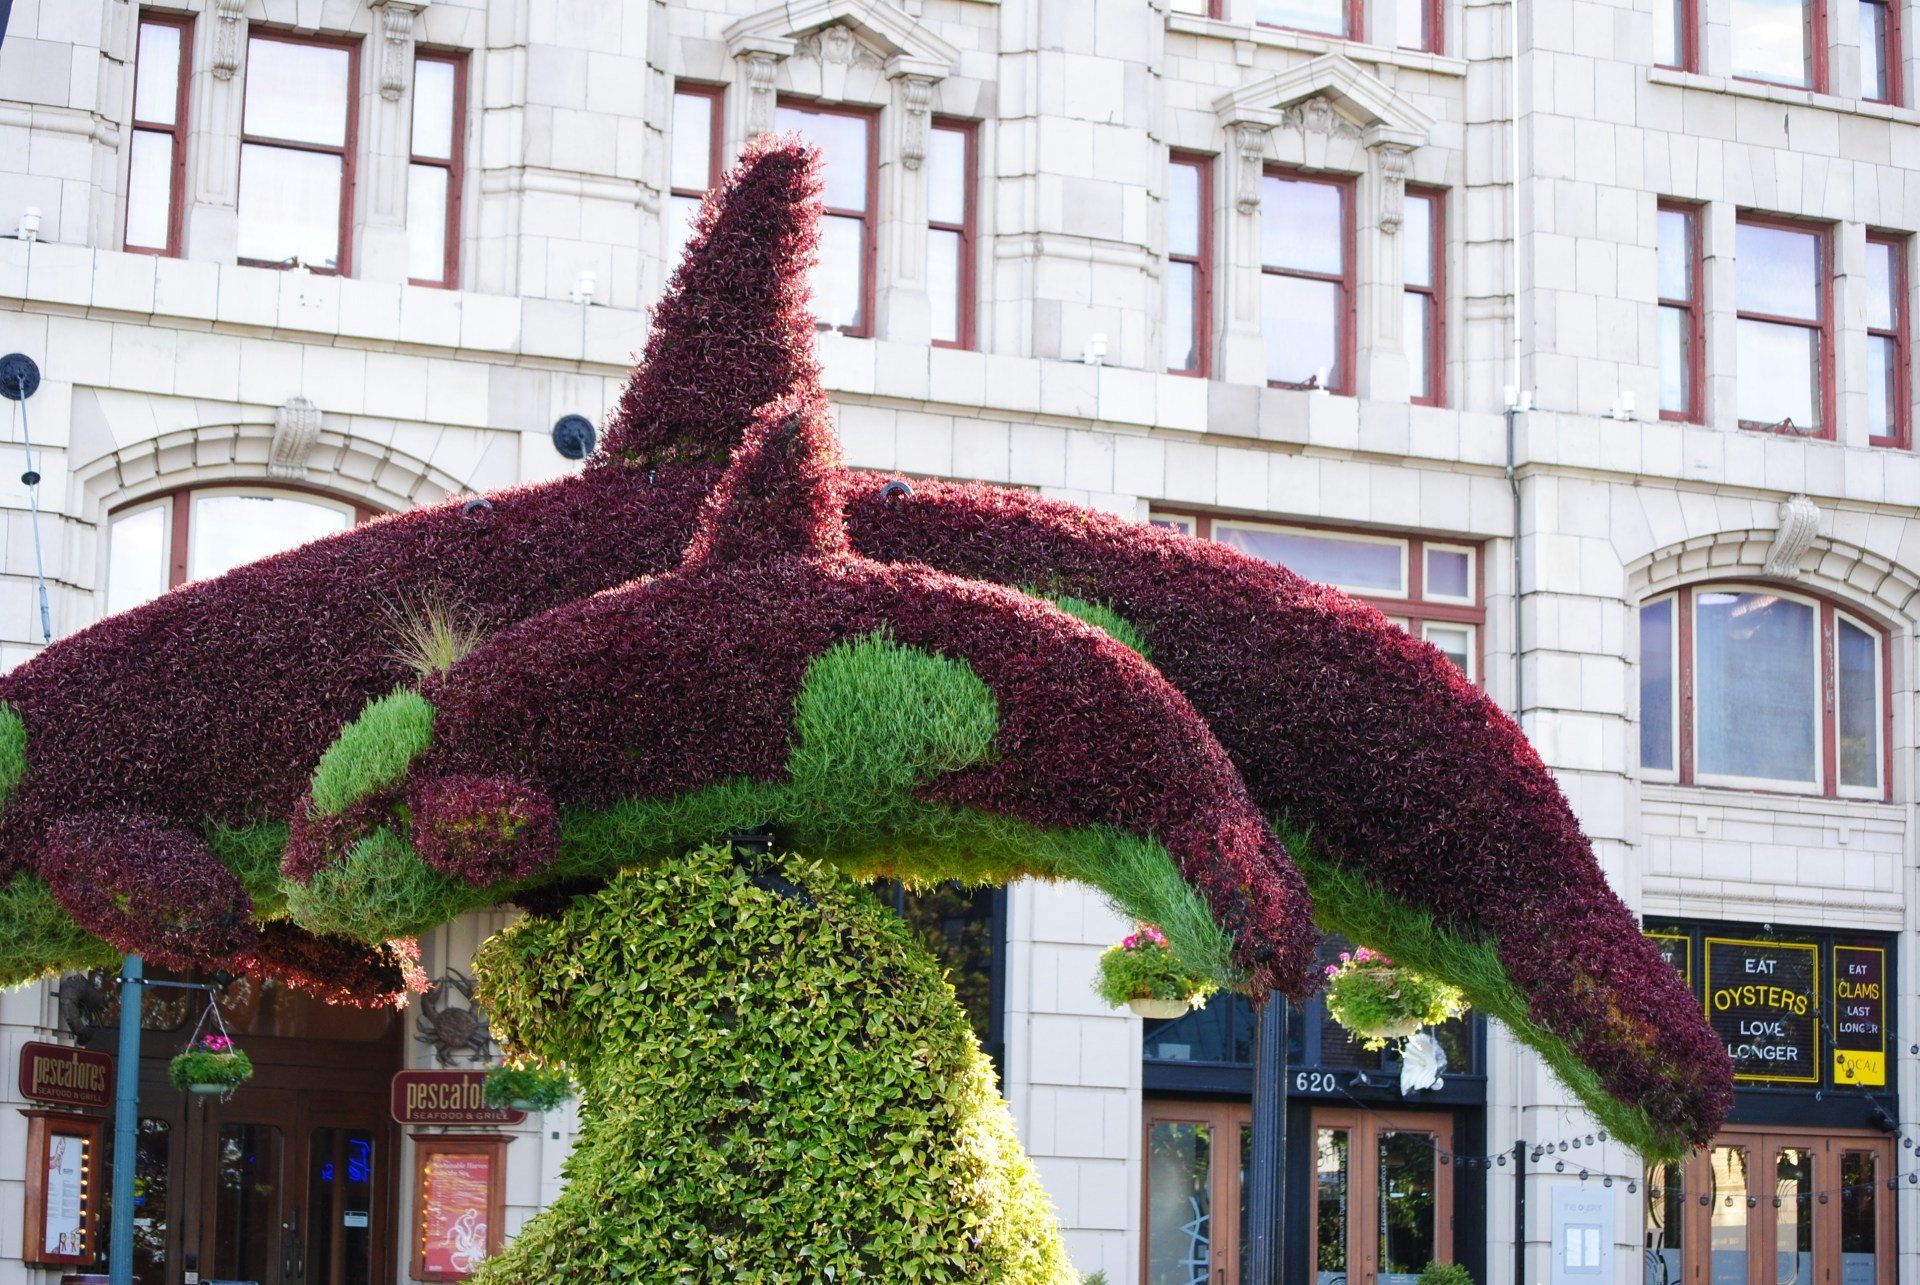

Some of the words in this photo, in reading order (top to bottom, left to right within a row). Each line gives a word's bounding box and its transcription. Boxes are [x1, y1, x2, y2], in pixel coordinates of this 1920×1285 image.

[1745, 959, 1777, 974] EAT
[1849, 964, 1867, 975] EAT
[1838, 981, 1879, 1000] CLAMS
[1714, 985, 1808, 1015] OYSTERS
[1847, 1006, 1870, 1017] LAST
[1740, 1020, 1785, 1037] LOVE
[1727, 1043, 1798, 1061] LONGER
[32, 1052, 106, 1094] pescatores
[1296, 1072, 1336, 1092] 620
[38, 1086, 72, 1099] SEAFOOD
[80, 1092, 103, 1103] GRILL
[406, 1073, 486, 1120] pescato
[413, 1111, 463, 1120] SEAFOOD
[466, 1111, 473, 1120] &
[476, 1111, 510, 1120] GRILL
